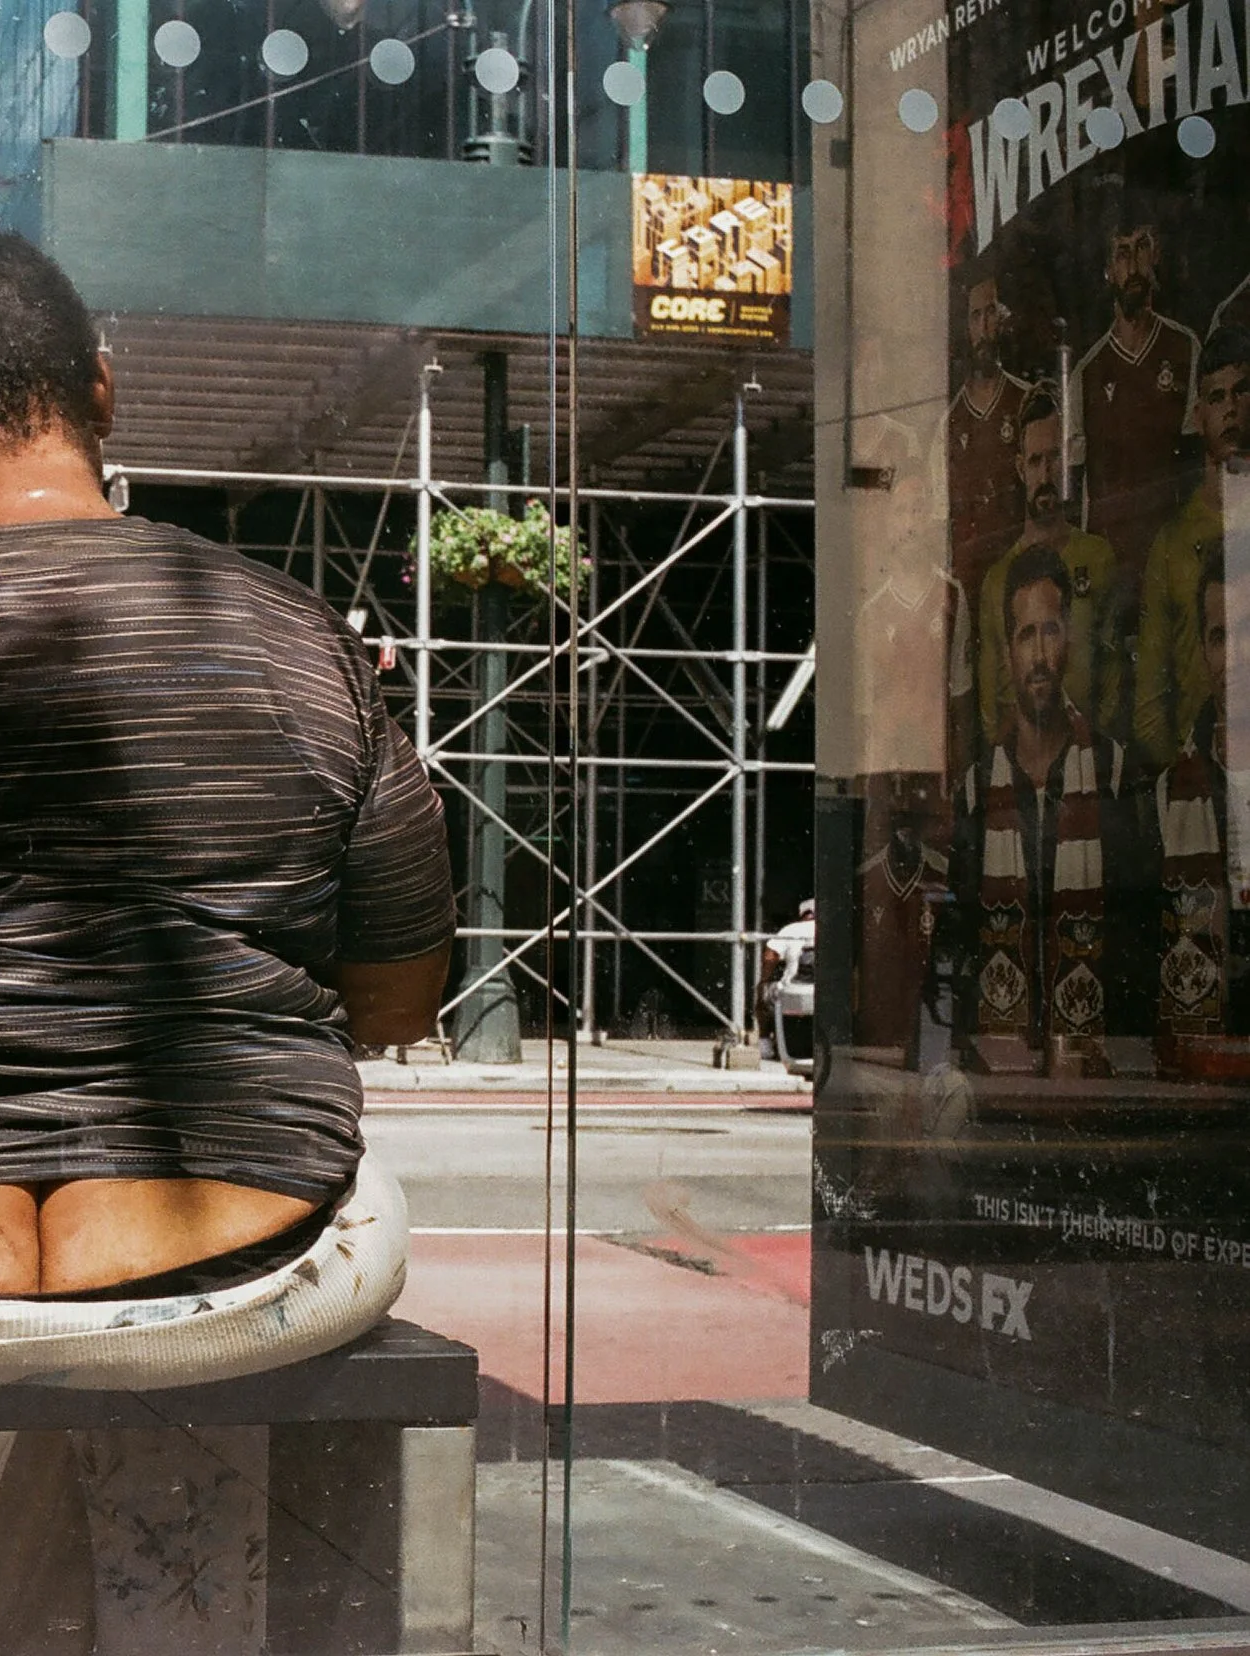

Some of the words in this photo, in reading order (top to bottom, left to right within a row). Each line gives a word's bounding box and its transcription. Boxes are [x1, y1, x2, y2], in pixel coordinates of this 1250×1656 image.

[889, 15, 950, 72] WRYAN
[969, 0, 1250, 256] WREXHA
[974, 1194, 1009, 1221] THIS
[1014, 1198, 1055, 1230] ISN'T
[1060, 1209, 1111, 1241] THEIR
[1113, 1217, 1166, 1252] FIELD
[1171, 1231, 1198, 1257] OF
[864, 1245, 973, 1324] WEDS
[981, 1272, 1034, 1341] FX
